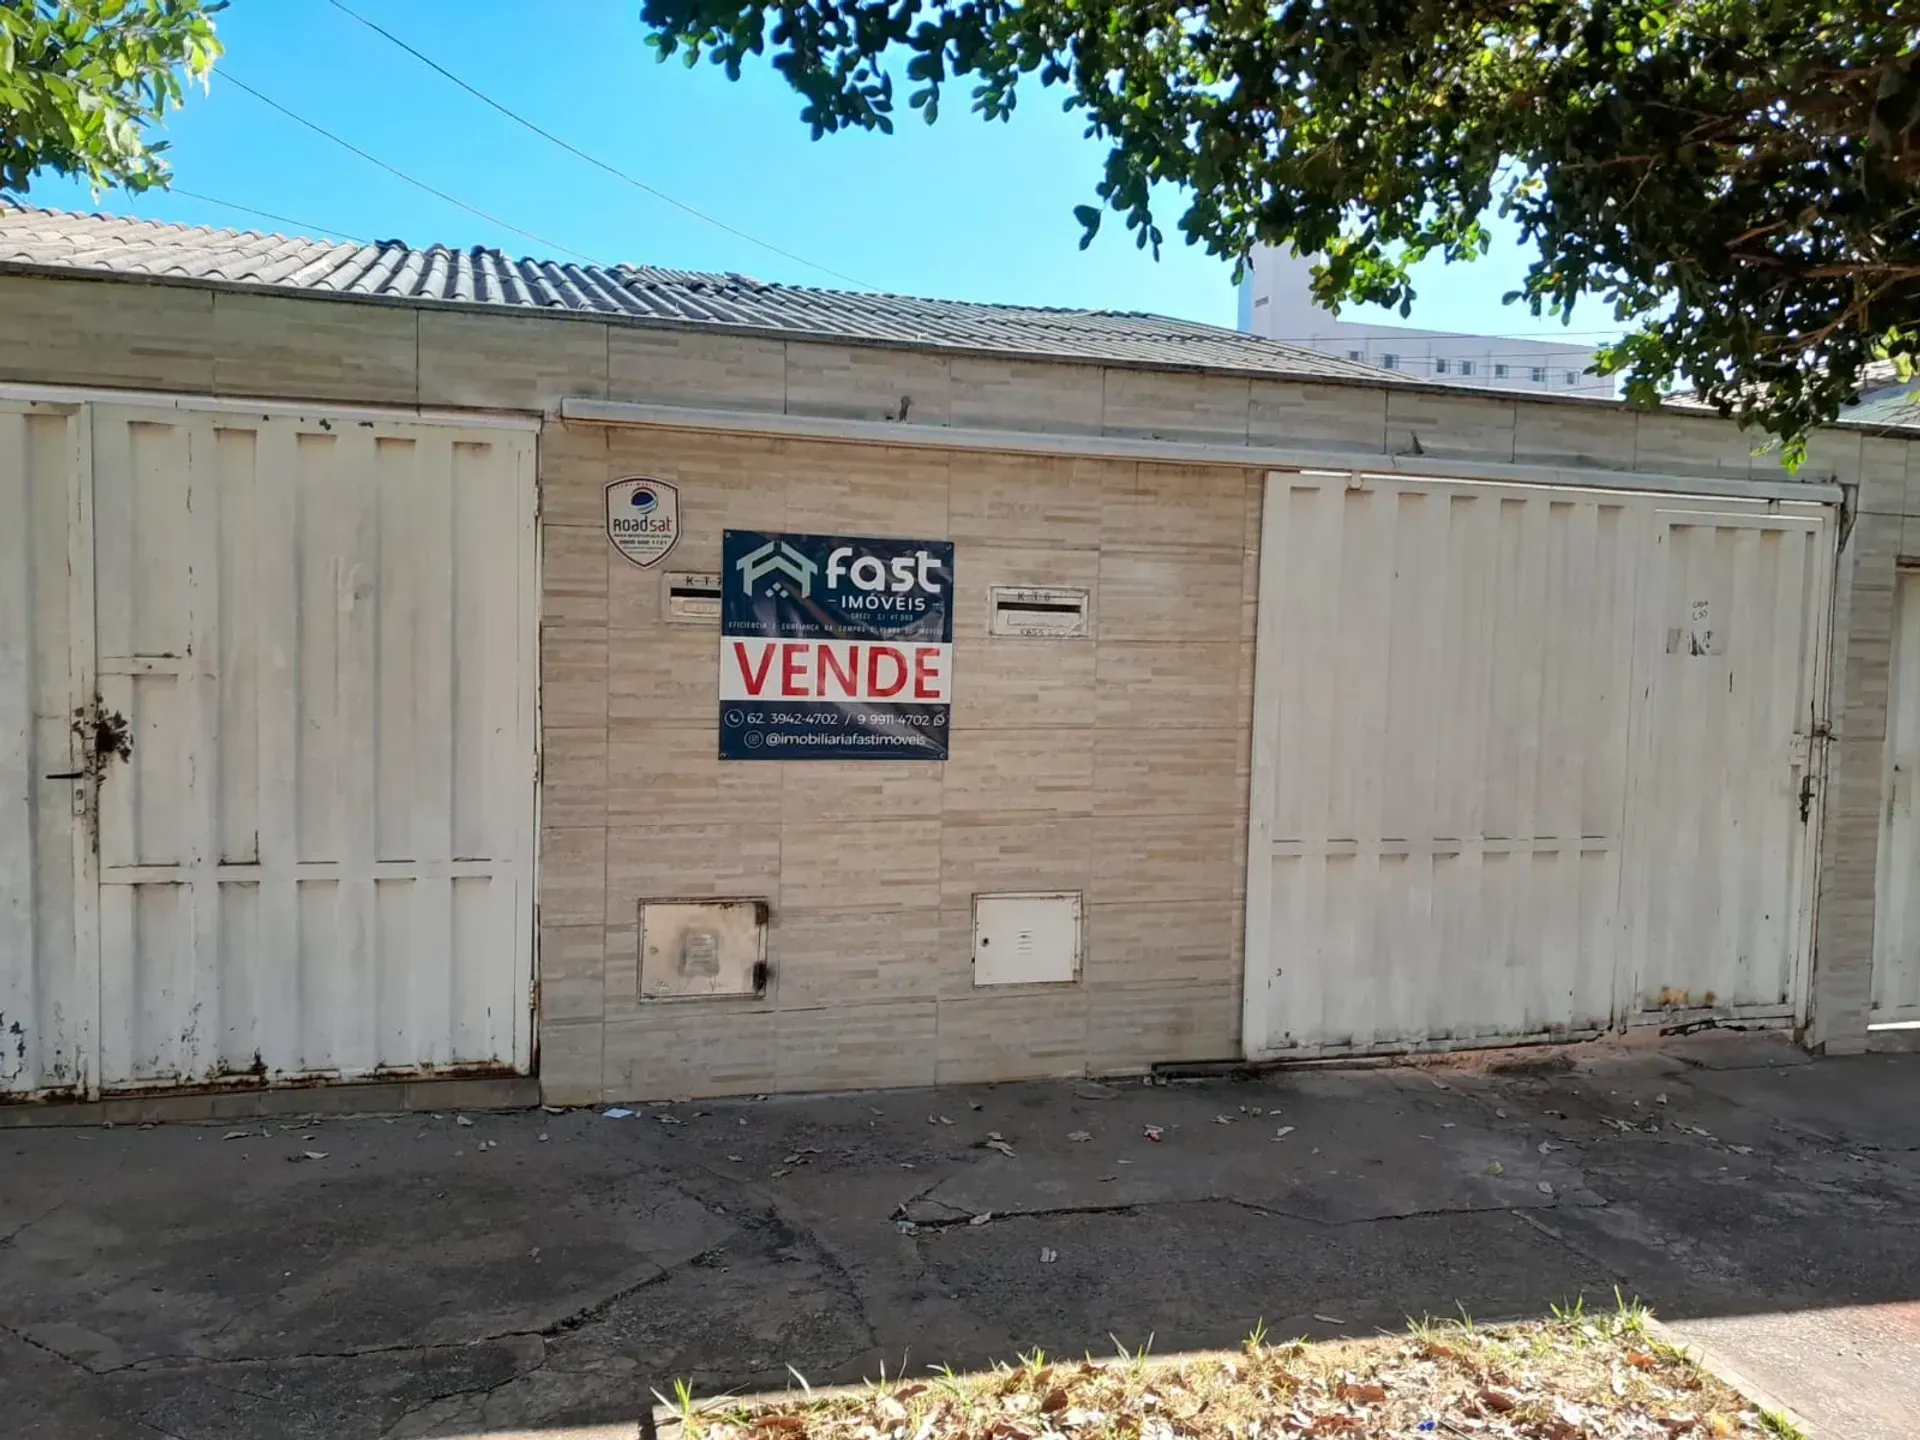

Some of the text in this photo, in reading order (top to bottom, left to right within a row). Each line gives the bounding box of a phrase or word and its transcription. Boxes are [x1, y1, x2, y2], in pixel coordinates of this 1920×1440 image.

[826, 547, 942, 593] fast
[841, 593, 926, 611] IMÓVEIS
[733, 642, 941, 698] VENDE
[747, 712, 765, 724] 62
[770, 712, 838, 725] 3942-4702
[857, 714, 866, 725] 9
[869, 714, 929, 726] 9911-4702
[765, 732, 926, 747] @imobiliariafastimoveis
